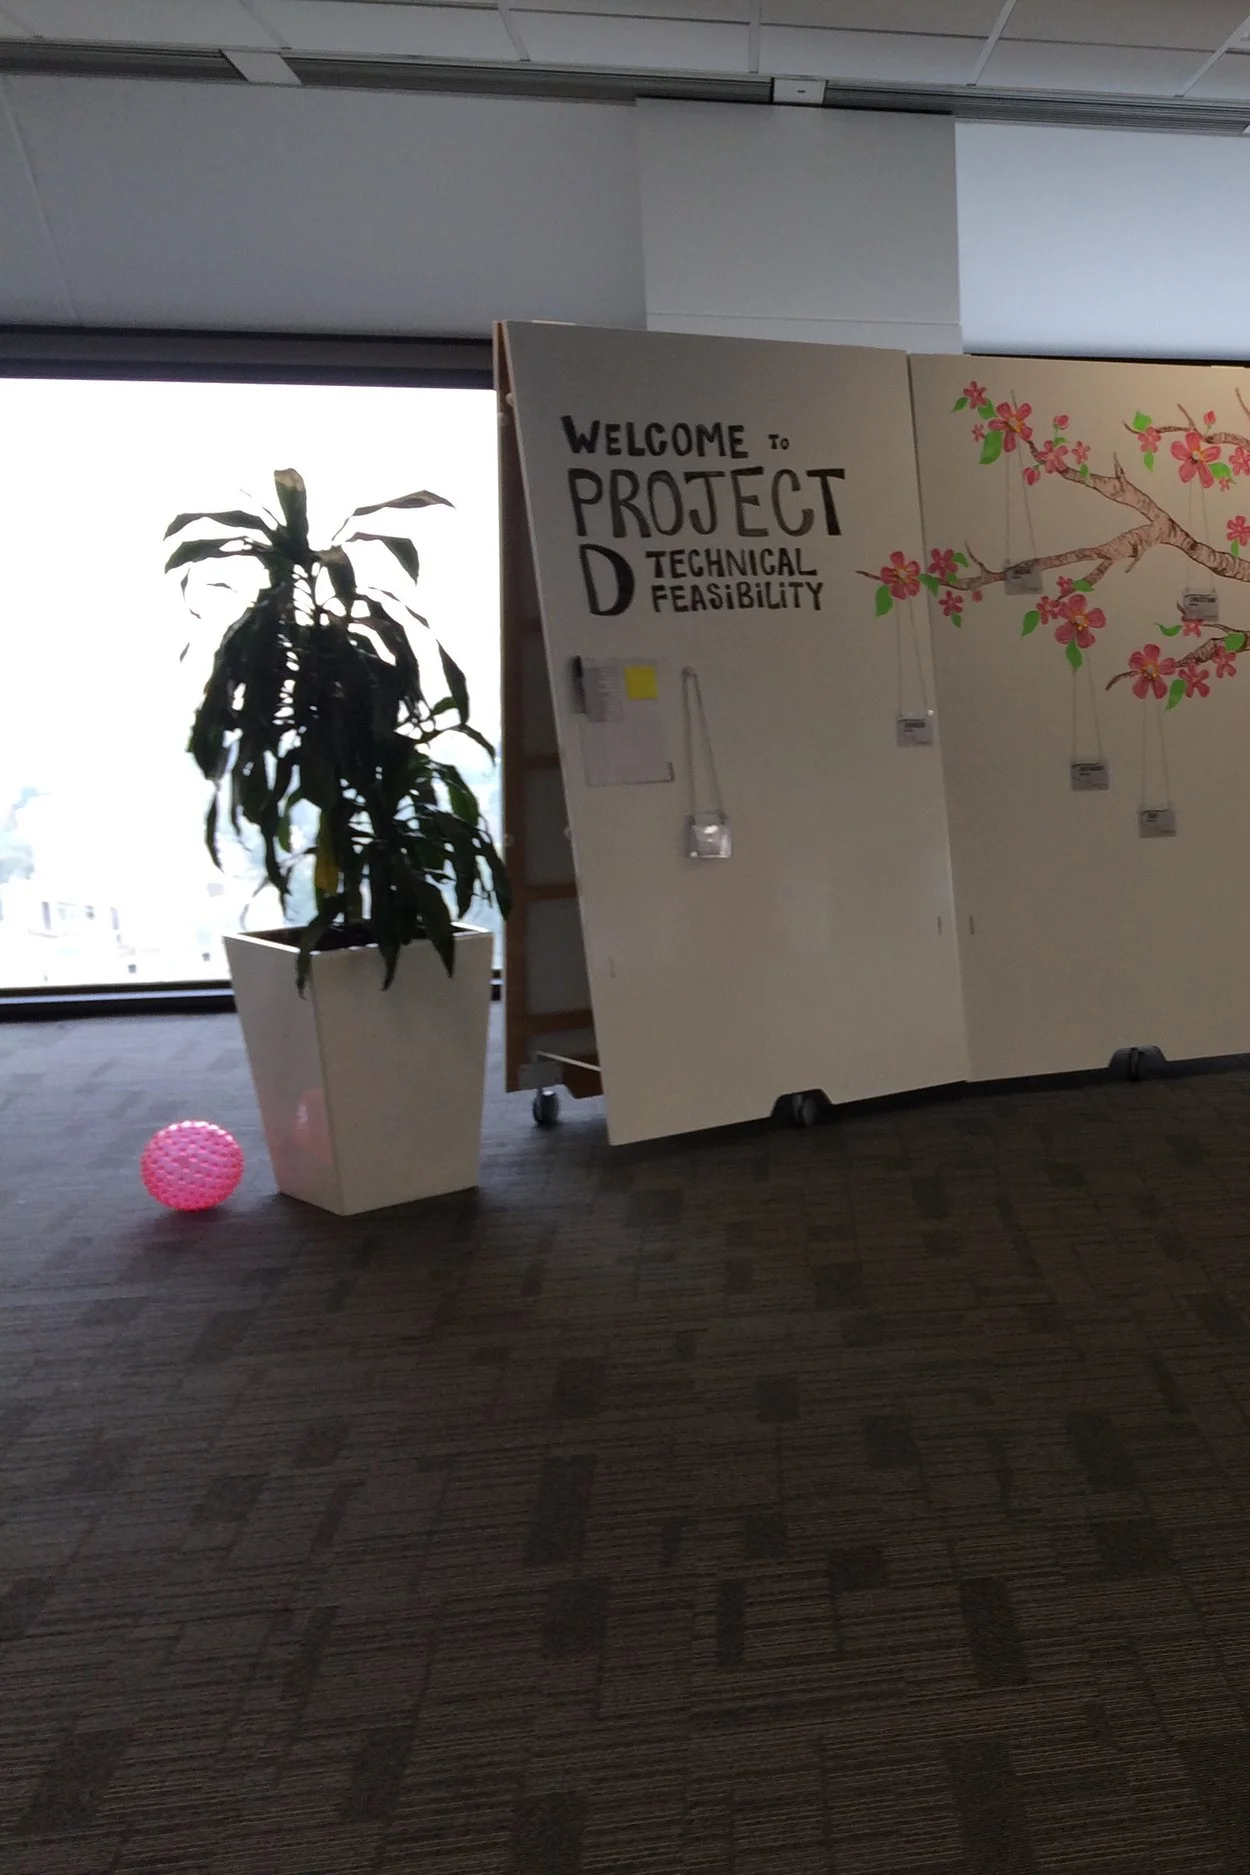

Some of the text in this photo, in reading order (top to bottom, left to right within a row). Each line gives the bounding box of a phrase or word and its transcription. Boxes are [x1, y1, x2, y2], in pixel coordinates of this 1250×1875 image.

[560, 415, 749, 459] WELCOME
[566, 466, 846, 538] PROJECT
[578, 543, 636, 616] D
[644, 547, 818, 579] TECHNICAL
